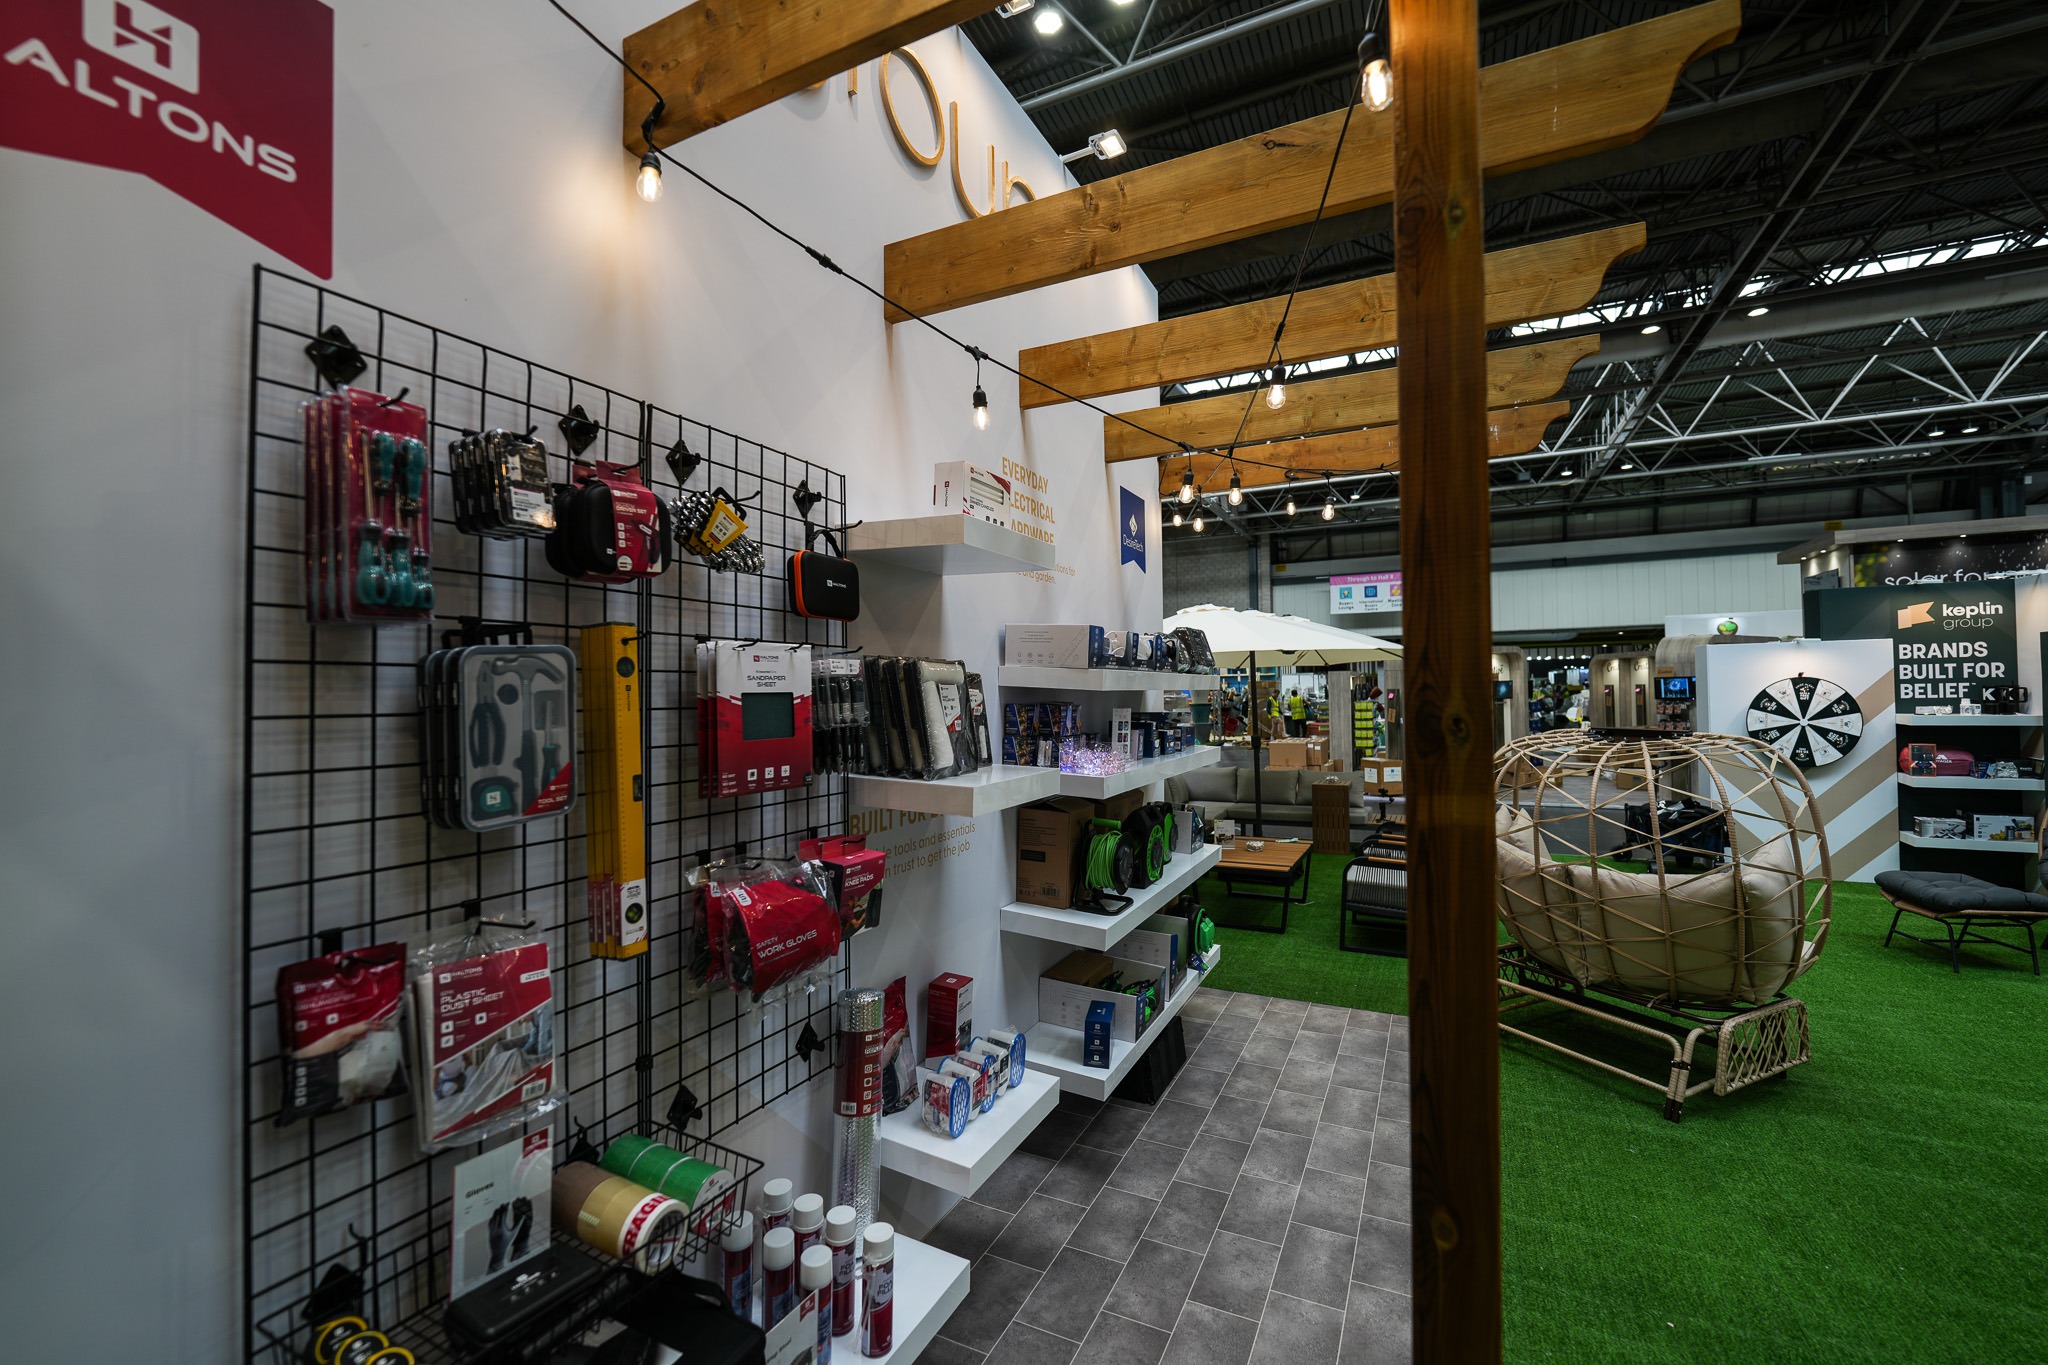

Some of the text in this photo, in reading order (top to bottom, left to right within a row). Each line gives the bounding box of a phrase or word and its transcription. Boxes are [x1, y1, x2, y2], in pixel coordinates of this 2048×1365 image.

[1002, 457, 1049, 494] EVERYDAY
[1123, 534, 1144, 553] DesireTech
[1942, 601, 2003, 619] keplin
[1943, 617, 1994, 631] group
[1898, 642, 1988, 660] BRANDS
[1899, 662, 2006, 680] BUILT FOR
[850, 808, 893, 836] BUILT
[894, 838, 917, 857] tools
[918, 831, 936, 849] and
[937, 821, 976, 843] essentials
[893, 857, 915, 876] trust
[916, 855, 925, 867] to
[927, 850, 942, 867] get
[943, 845, 956, 858] the
[957, 839, 971, 857] job
[844, 878, 860, 887] KNEE
[859, 873, 874, 884] PADS
[755, 935, 779, 950] SAFETY
[757, 943, 786, 959] WORK
[785, 929, 818, 947] GLOVES
[440, 987, 487, 1004] PLASTIC
[440, 998, 473, 1013] DUST
[472, 991, 505, 1006] SHEET
[464, 1181, 495, 1199] Gloves
